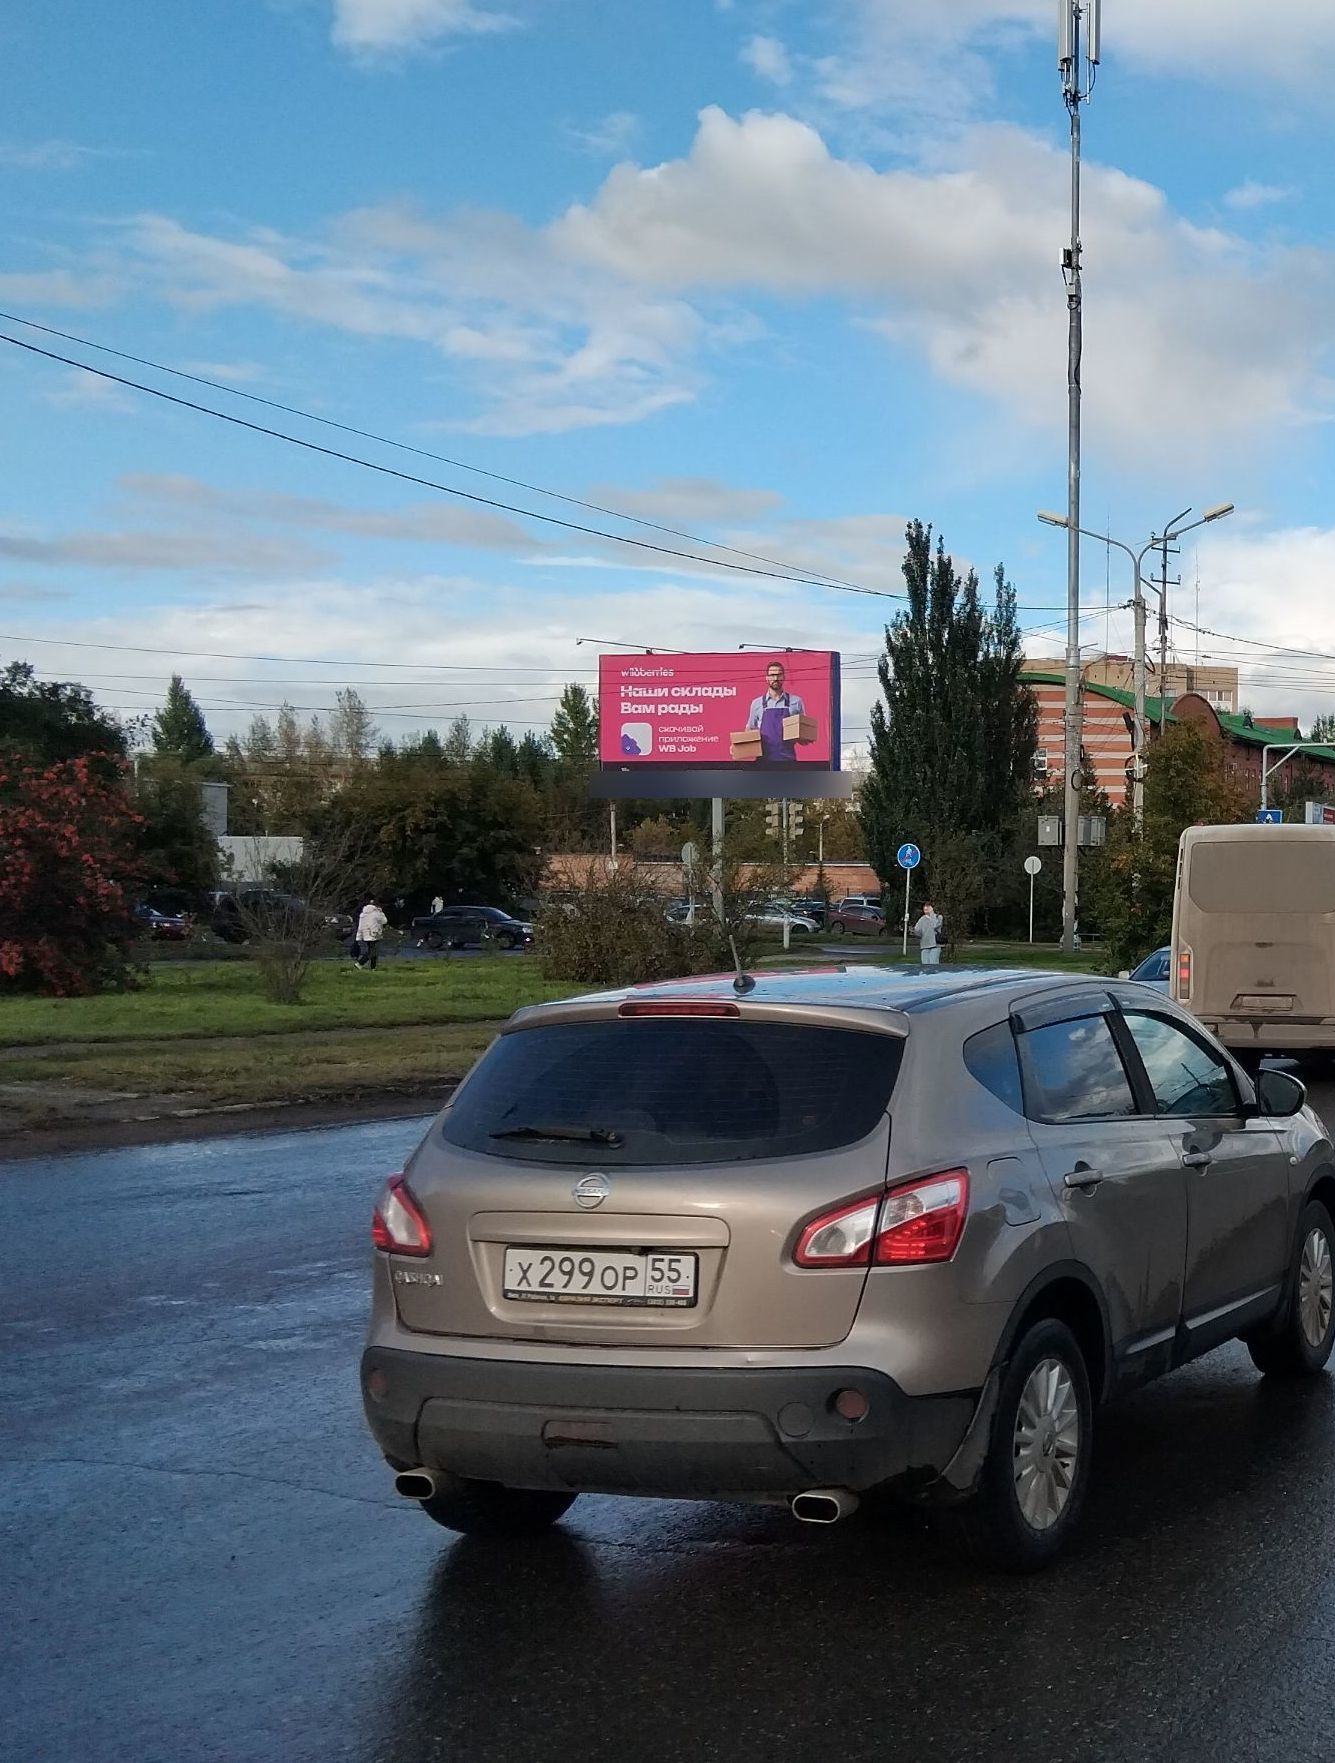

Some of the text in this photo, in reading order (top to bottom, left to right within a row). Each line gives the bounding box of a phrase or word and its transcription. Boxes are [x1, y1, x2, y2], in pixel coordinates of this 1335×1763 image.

[621, 667, 674, 677] wildberries
[620, 685, 737, 698] Наши склады
[620, 702, 703, 716] Вам рады
[658, 725, 704, 733] скачивай
[658, 735, 719, 744] приложение
[658, 744, 697, 753] WB Job
[650, 1257, 682, 1284] 55
[648, 1285, 672, 1295] RUS
